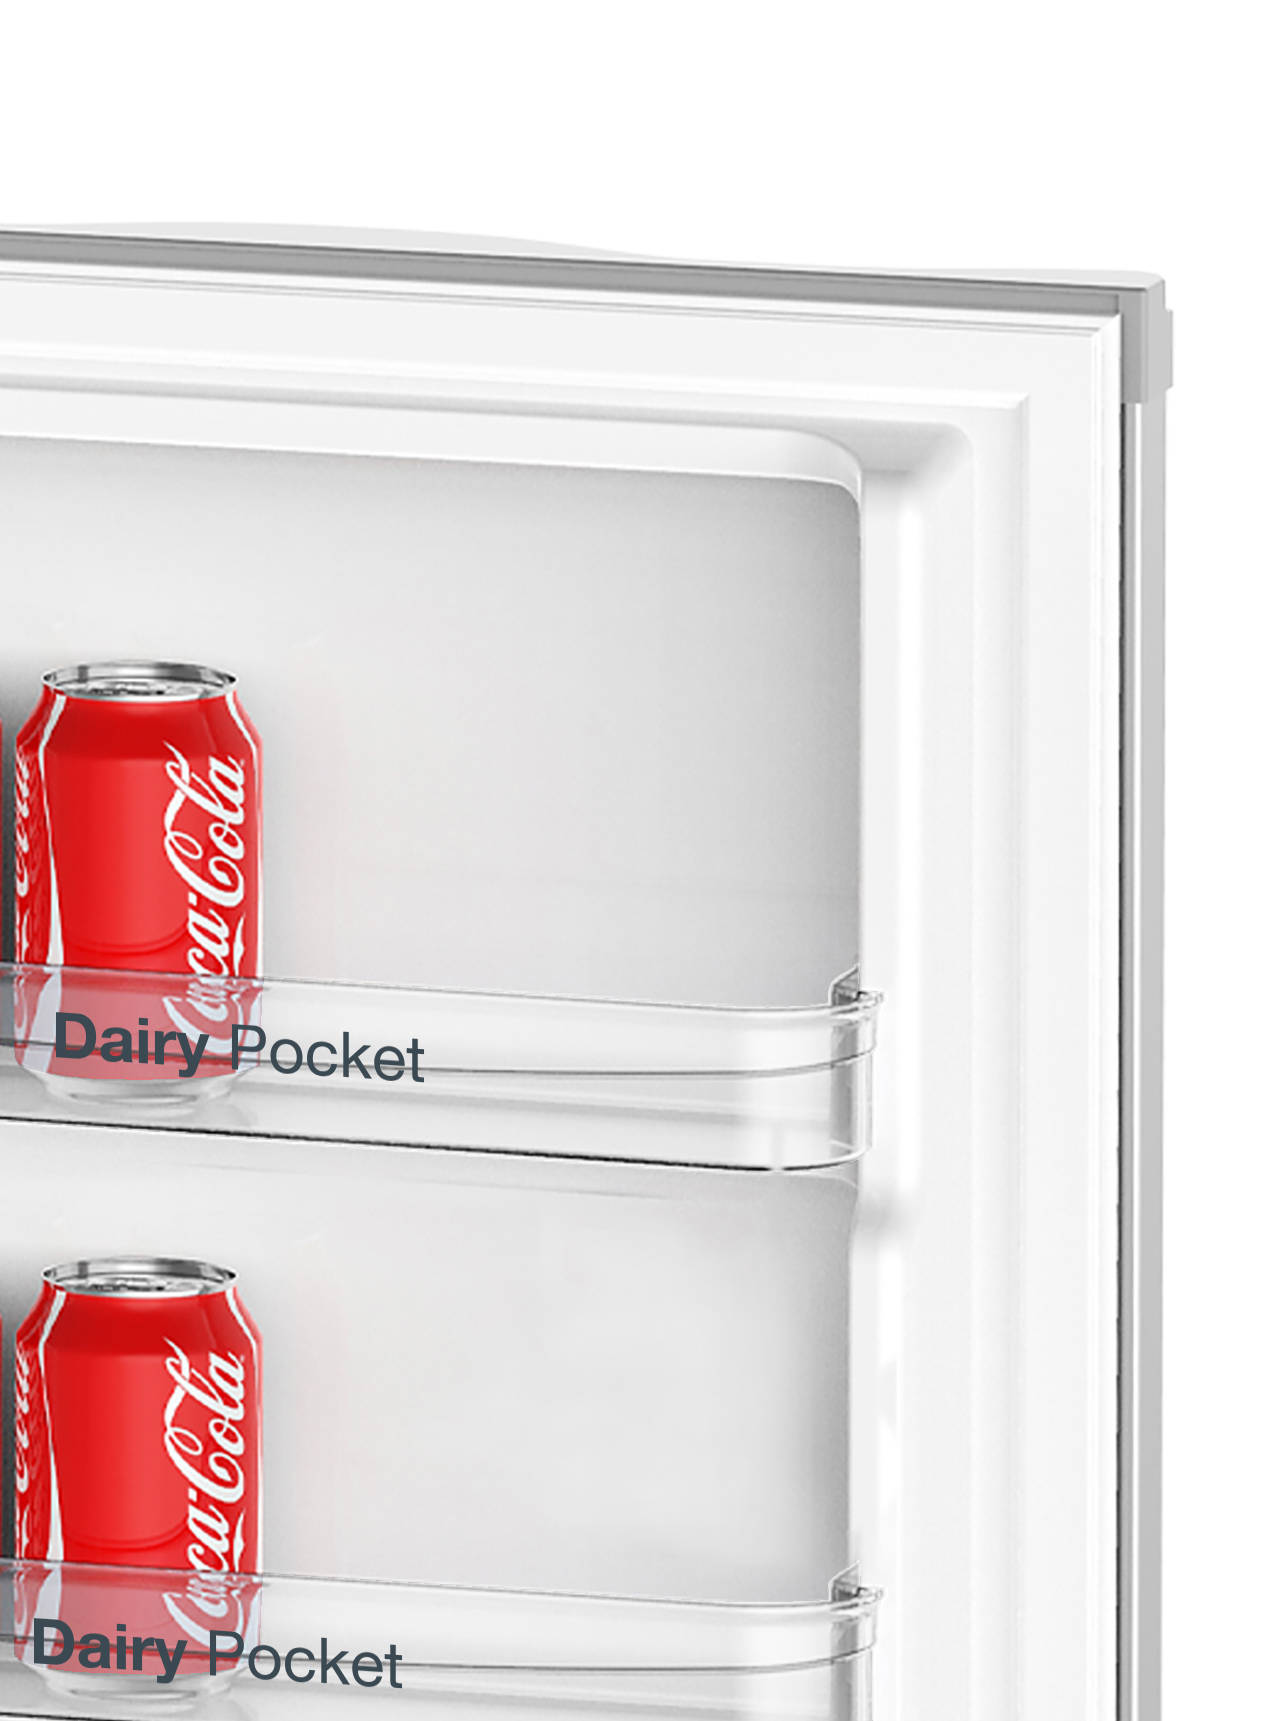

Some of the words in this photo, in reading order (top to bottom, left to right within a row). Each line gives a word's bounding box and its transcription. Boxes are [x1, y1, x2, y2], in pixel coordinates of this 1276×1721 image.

[54, 1010, 210, 1078] Dairy
[230, 1023, 425, 1083] Pocket
[32, 1617, 189, 1684] Dairy
[209, 1629, 403, 1690] Pocket
